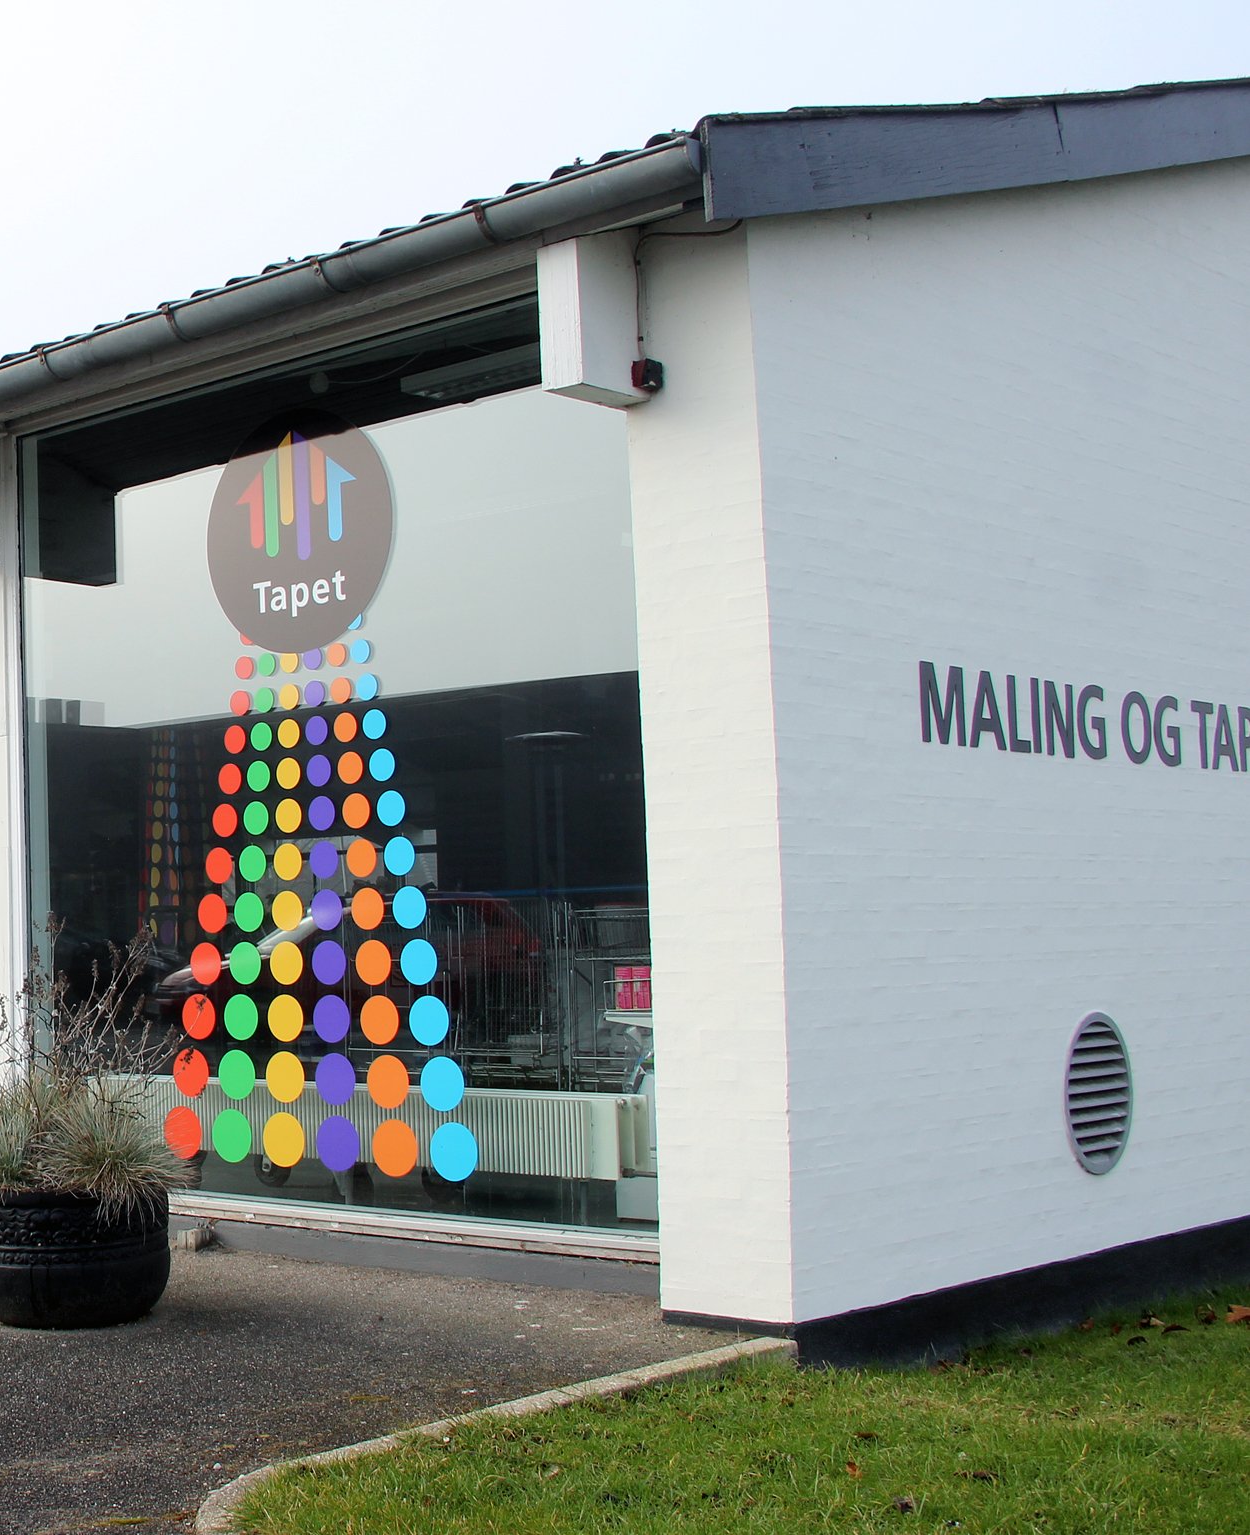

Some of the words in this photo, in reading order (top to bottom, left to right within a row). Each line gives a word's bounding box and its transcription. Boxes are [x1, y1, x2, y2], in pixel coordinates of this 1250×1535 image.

[252, 569, 347, 618] Tapet
[918, 660, 1108, 760] MALING
[1120, 690, 1182, 767] OG
